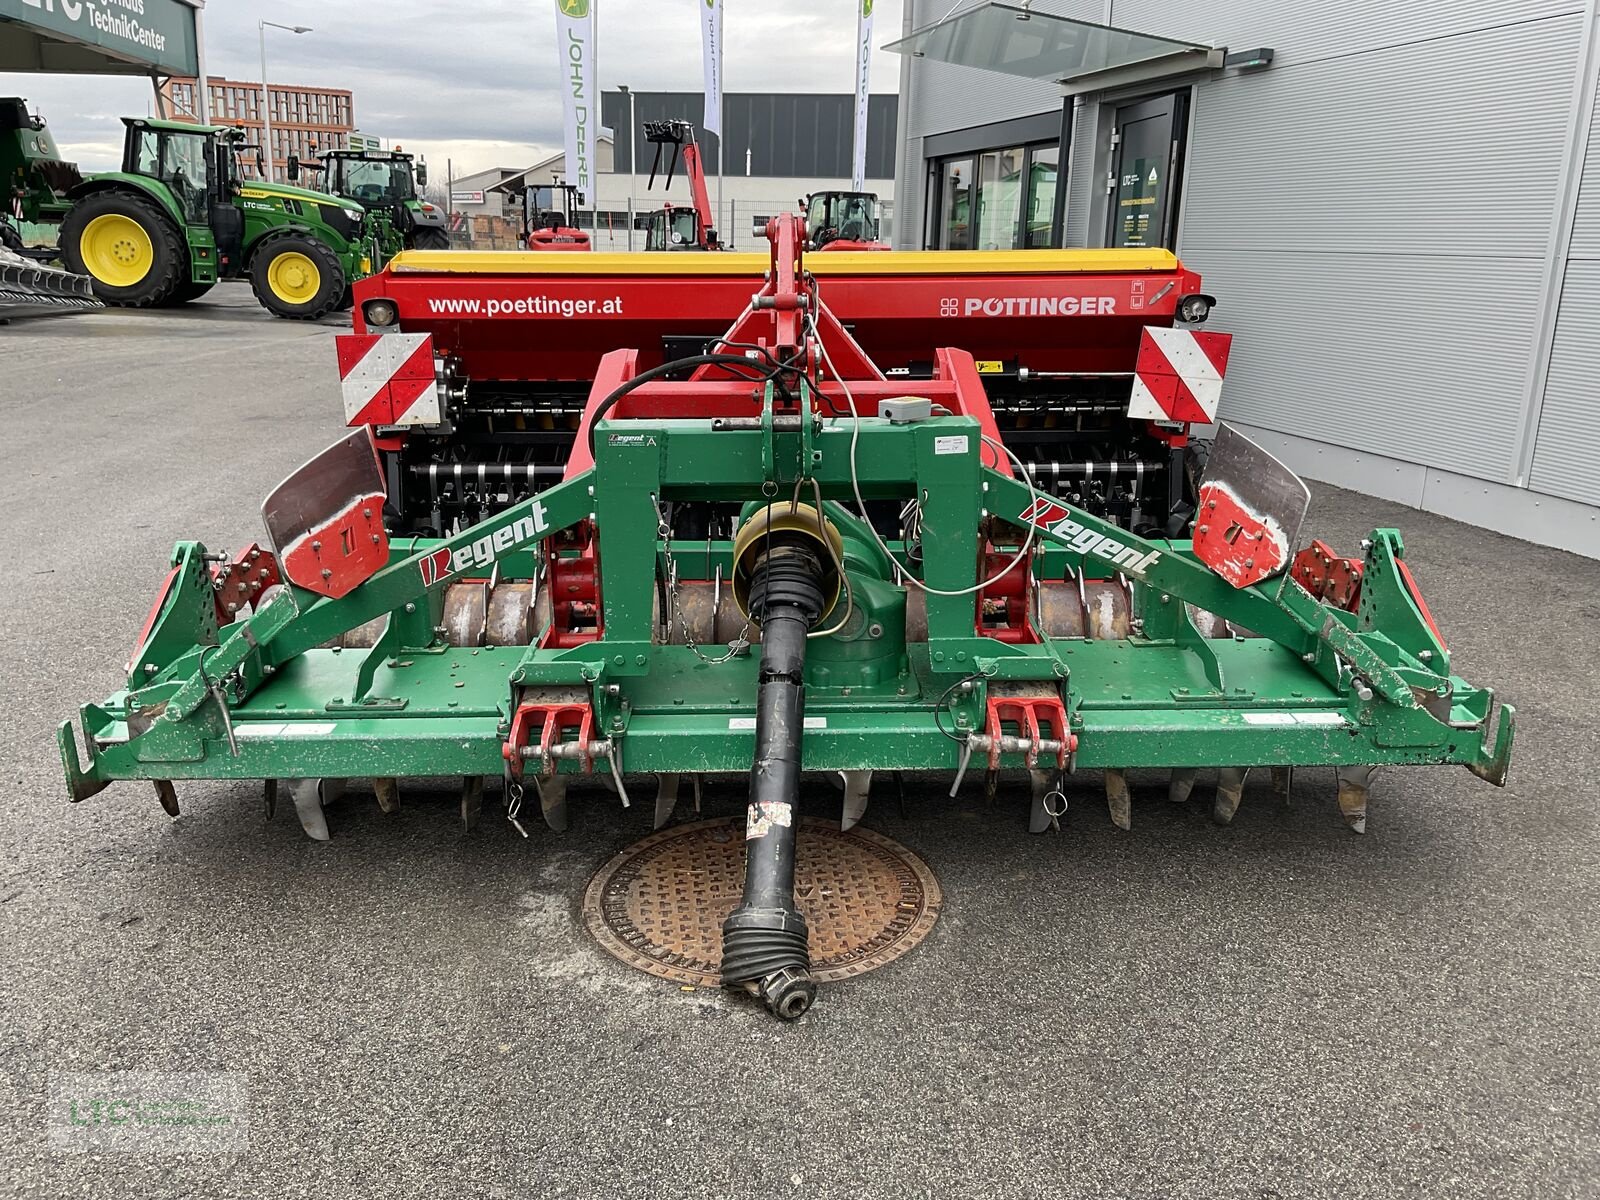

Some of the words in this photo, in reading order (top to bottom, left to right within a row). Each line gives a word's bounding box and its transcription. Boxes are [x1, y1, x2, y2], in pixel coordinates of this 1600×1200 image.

[86, 2, 166, 51] TechnikCenter
[568, 28, 584, 99] JOHN
[575, 106, 588, 188] DEERE
[243, 201, 256, 209] LTC
[428, 295, 623, 317] www.poettinger.at
[965, 296, 1116, 316] PÖTTINGER
[609, 433, 645, 444] Regent
[418, 500, 550, 588] Regent
[1018, 496, 1162, 575] Regent
